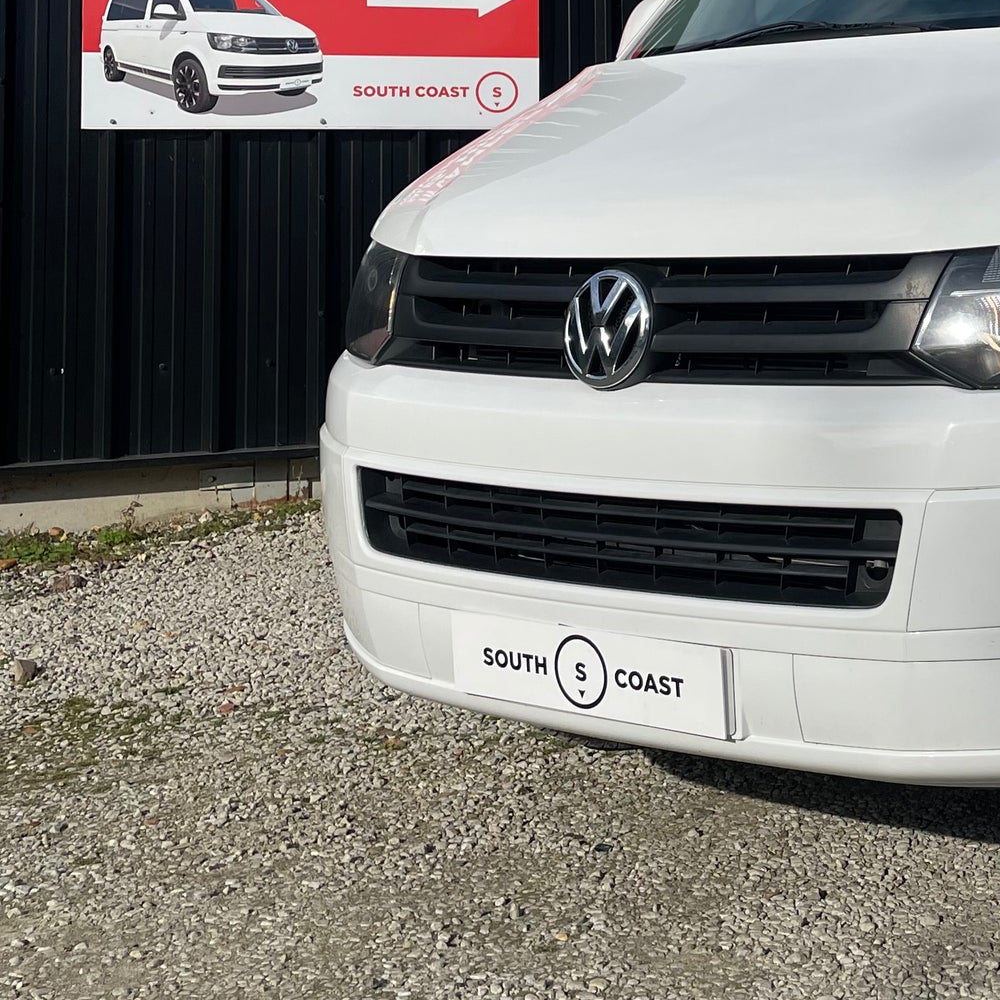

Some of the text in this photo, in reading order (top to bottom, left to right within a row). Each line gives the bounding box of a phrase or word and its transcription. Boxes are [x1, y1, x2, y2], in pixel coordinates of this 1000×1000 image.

[353, 85, 502, 98] SOUTH COAST S
[564, 269, 651, 389] VW
[483, 647, 684, 698] SOUTH S COAST
